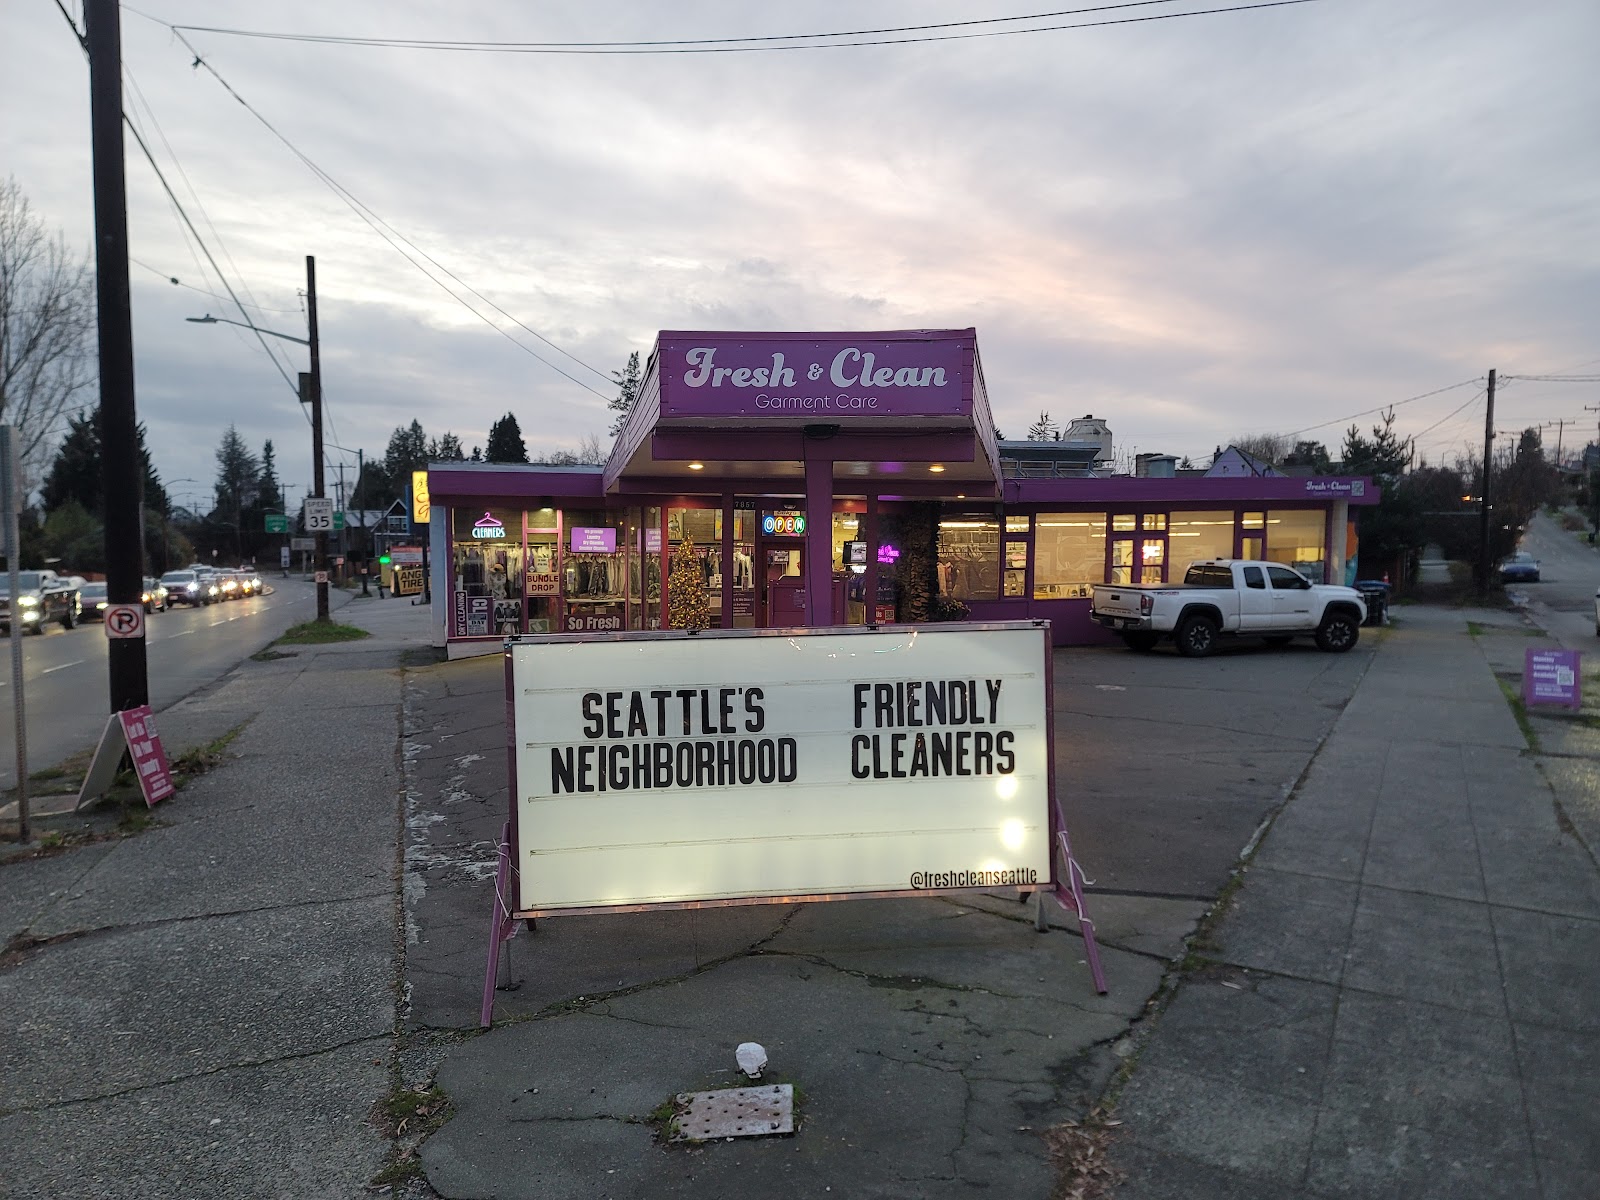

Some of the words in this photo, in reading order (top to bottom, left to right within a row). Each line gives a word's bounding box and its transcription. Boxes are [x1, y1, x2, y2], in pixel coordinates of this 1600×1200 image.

[684, 347, 797, 388] Fresh
[807, 363, 823, 381] &
[830, 347, 948, 388] Clean
[755, 393, 830, 409] Garment
[835, 393, 878, 409] Care
[1306, 481, 1326, 490] Fresh
[1331, 481, 1350, 490] Clean
[310, 516, 329, 528] 35
[765, 517, 804, 532] OPEN
[472, 527, 506, 538] CLEANERS
[400, 570, 423, 580] ANG
[527, 575, 559, 583] BUNDLE
[457, 592, 466, 622] CLEANING
[458, 623, 466, 635] DRY
[568, 617, 583, 630] So
[586, 616, 620, 630] Fresh
[854, 679, 1002, 728] FRIENDLY
[582, 688, 765, 738] SEATTLE'S
[851, 731, 1015, 779] CLEANERS
[551, 737, 797, 794] NEIGHBORHOOD
[910, 867, 1037, 890] @freshcleanseattle
